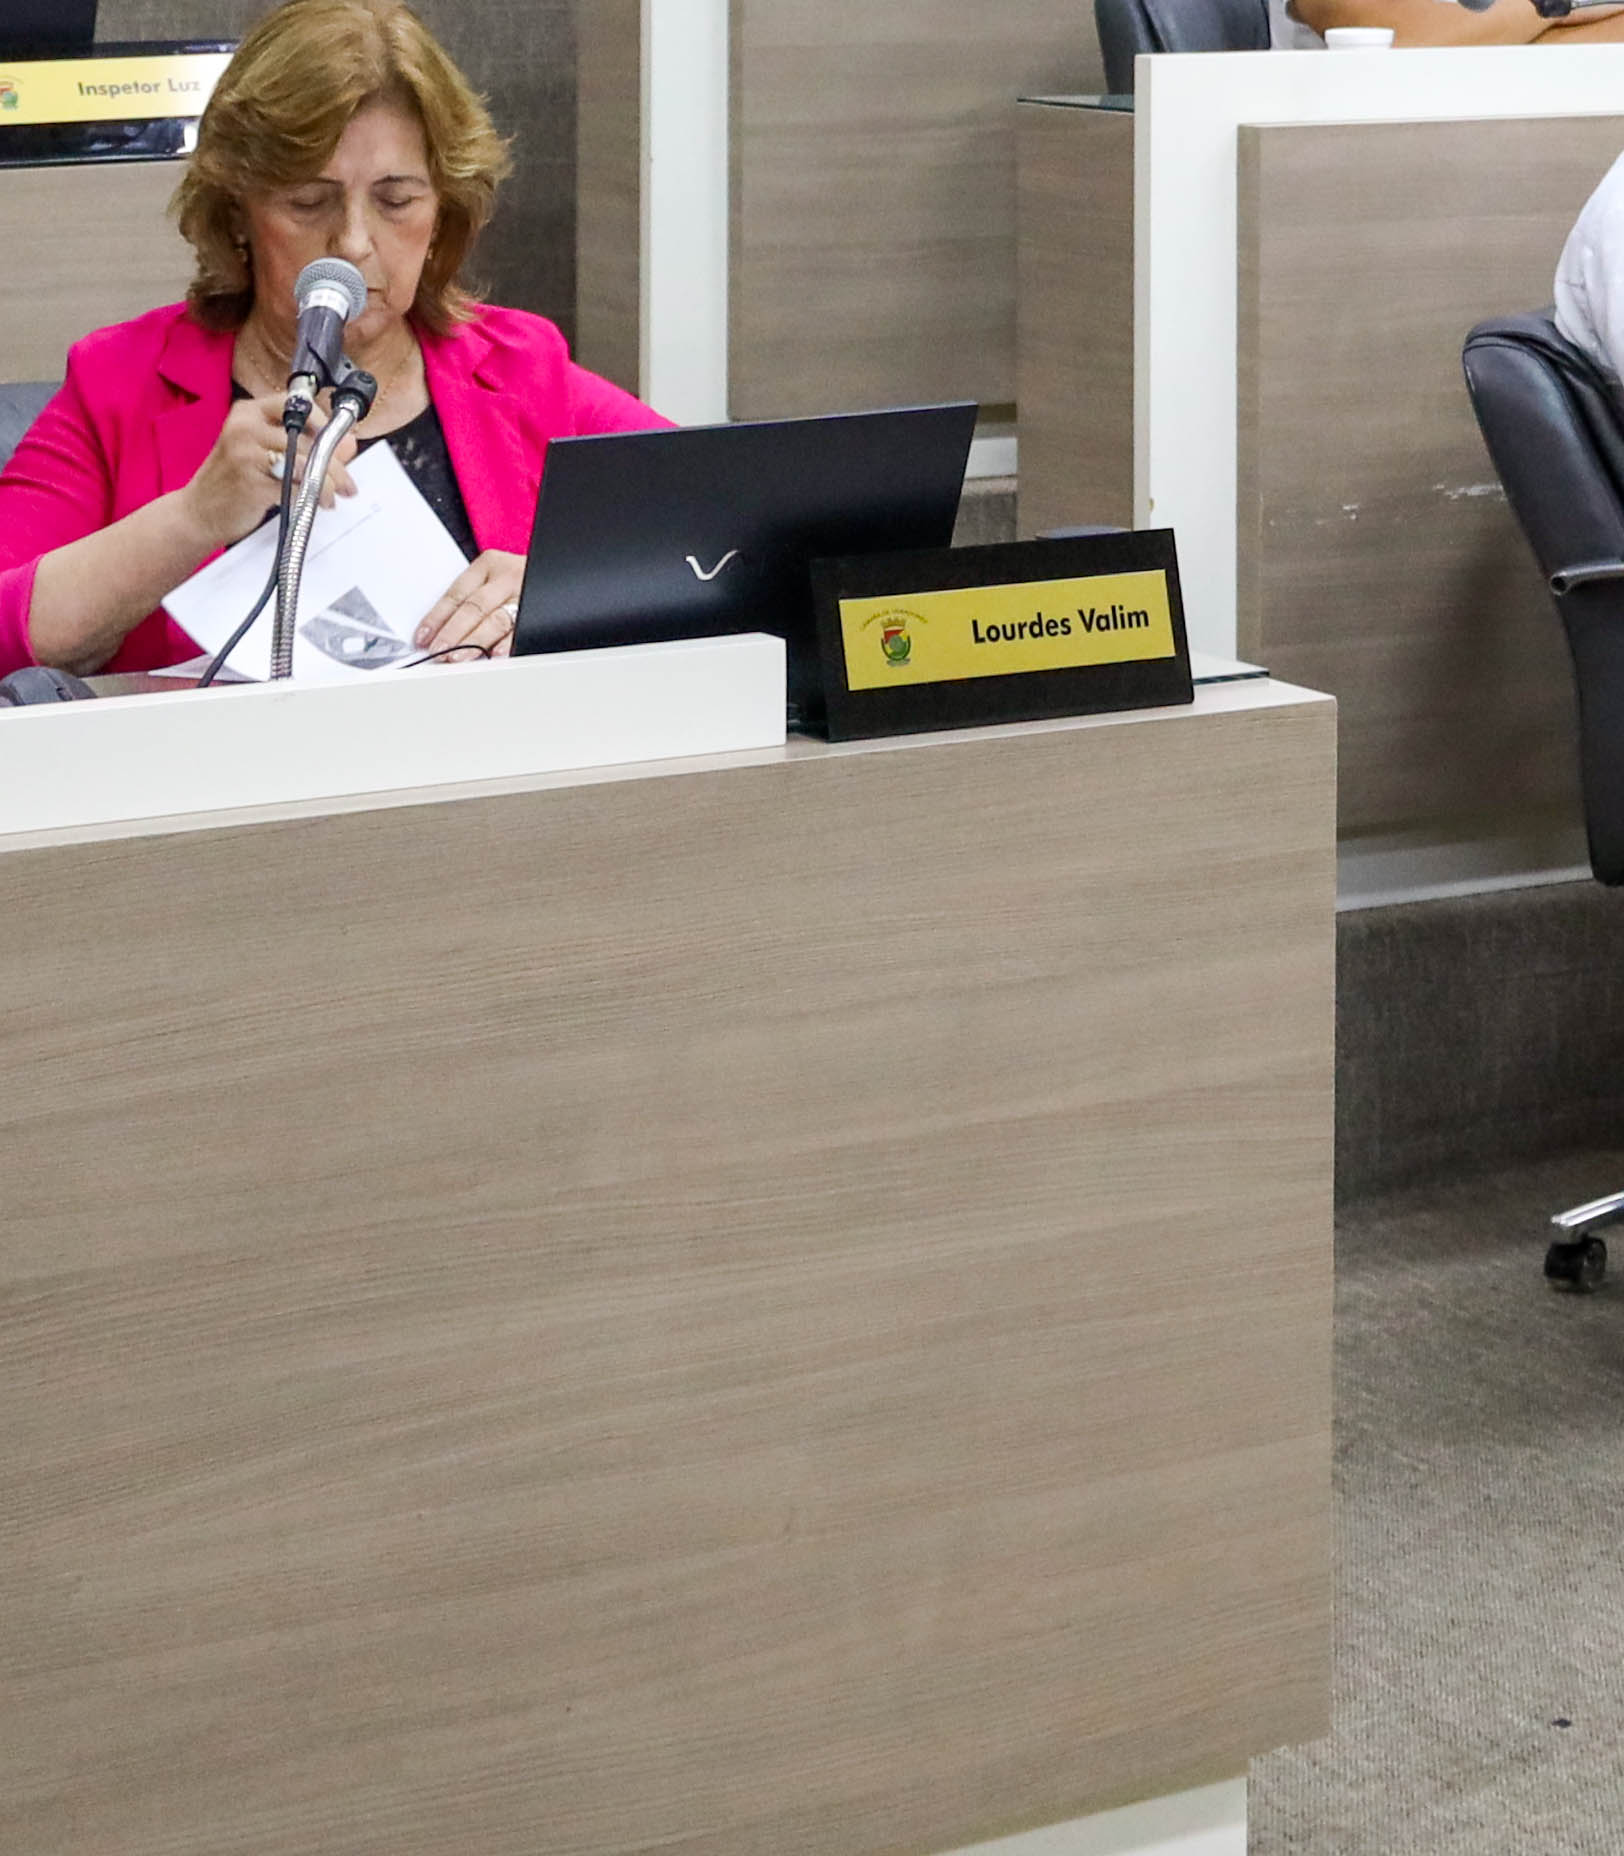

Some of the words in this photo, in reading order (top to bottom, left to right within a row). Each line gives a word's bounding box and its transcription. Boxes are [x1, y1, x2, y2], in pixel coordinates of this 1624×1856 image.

[77, 80, 161, 100] Inspetor
[167, 78, 201, 93] Luz
[971, 611, 1072, 644] Lourdes
[1077, 604, 1150, 634] Valim
